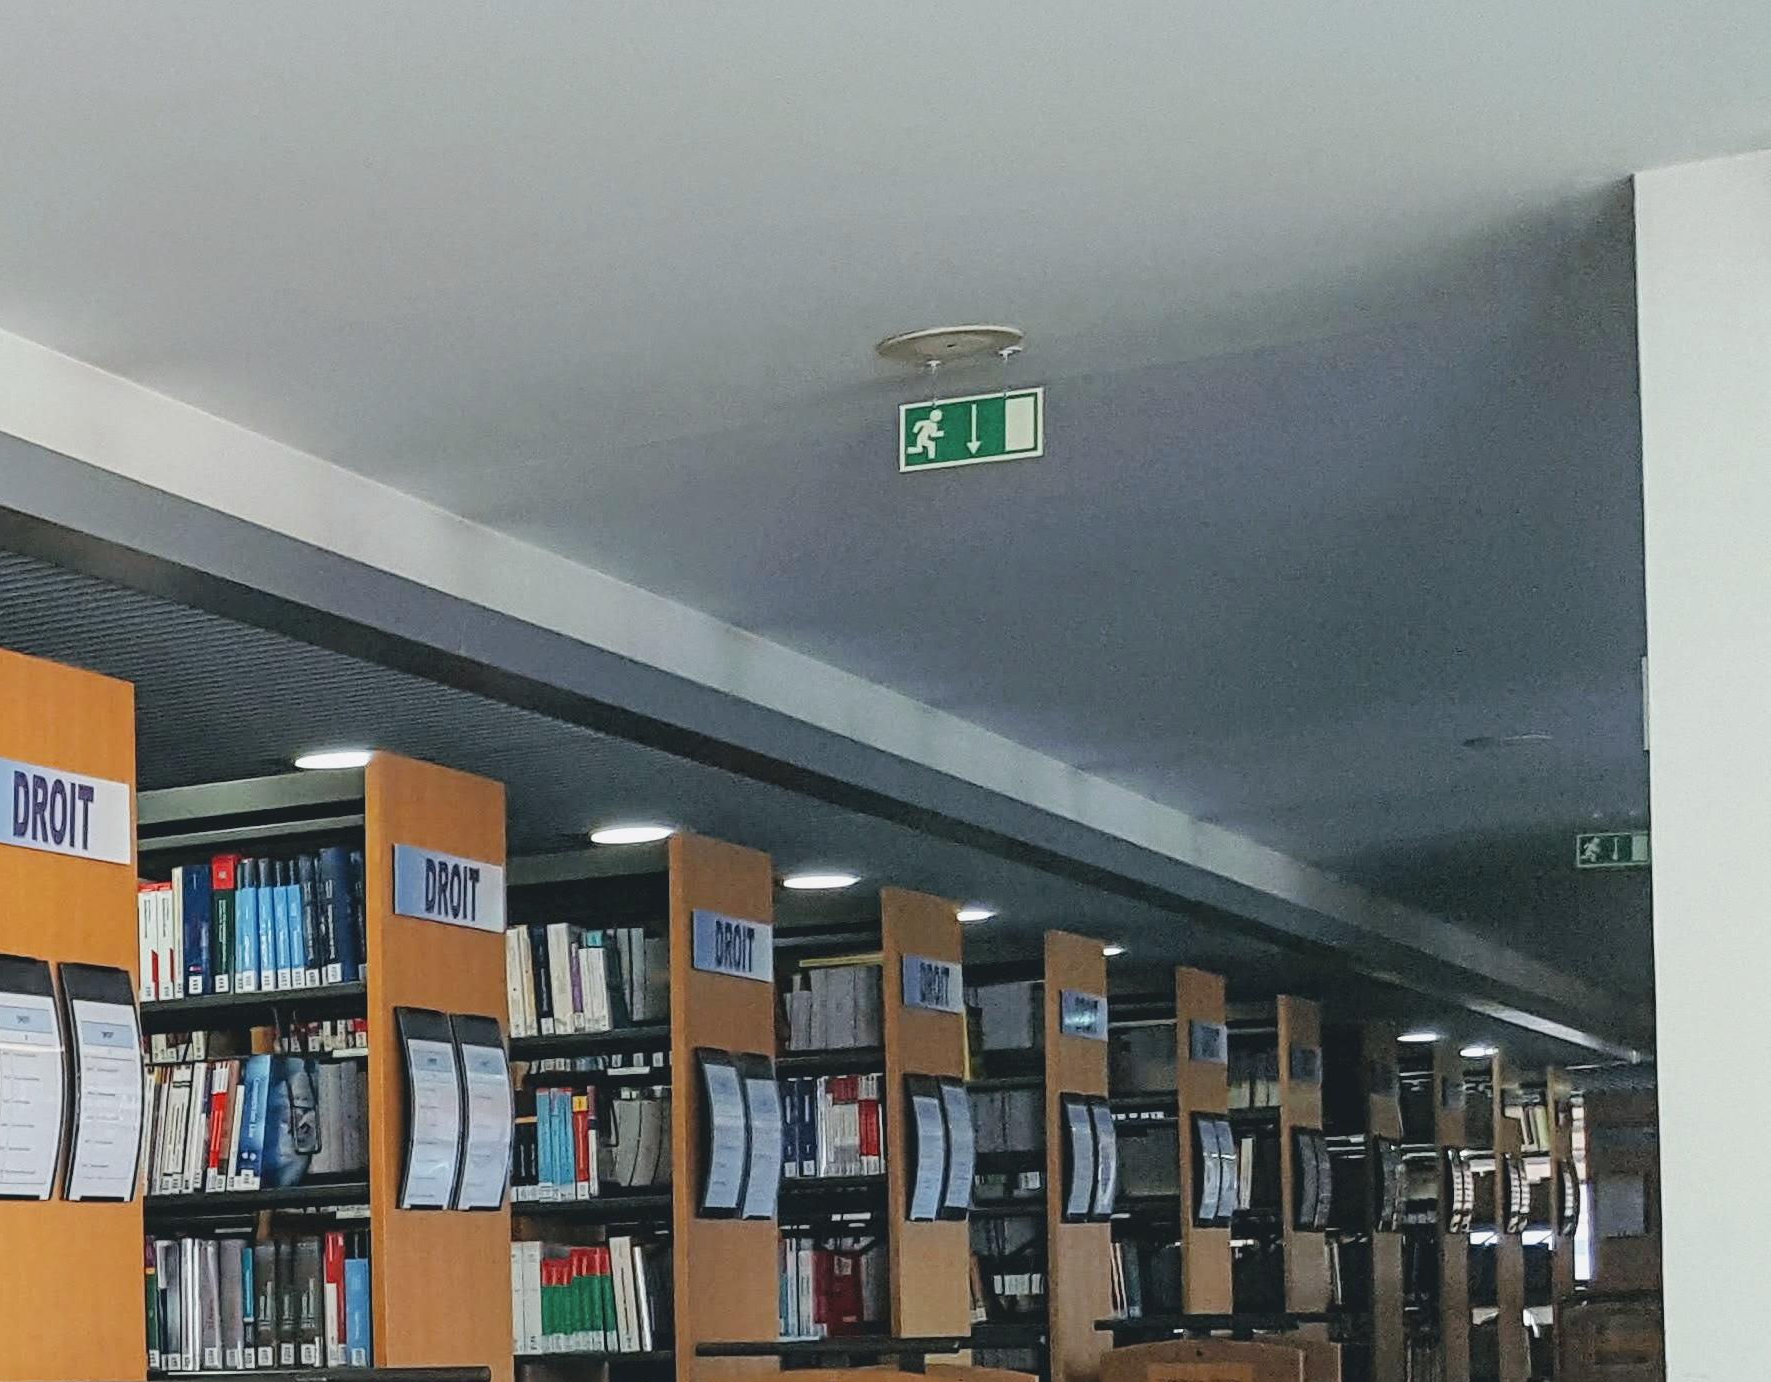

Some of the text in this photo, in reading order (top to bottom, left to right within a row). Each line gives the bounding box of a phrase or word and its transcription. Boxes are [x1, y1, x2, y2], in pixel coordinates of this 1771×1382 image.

[12, 770, 94, 850] DROIT
[425, 858, 481, 921] DROIT
[714, 918, 756, 973] DROIT
